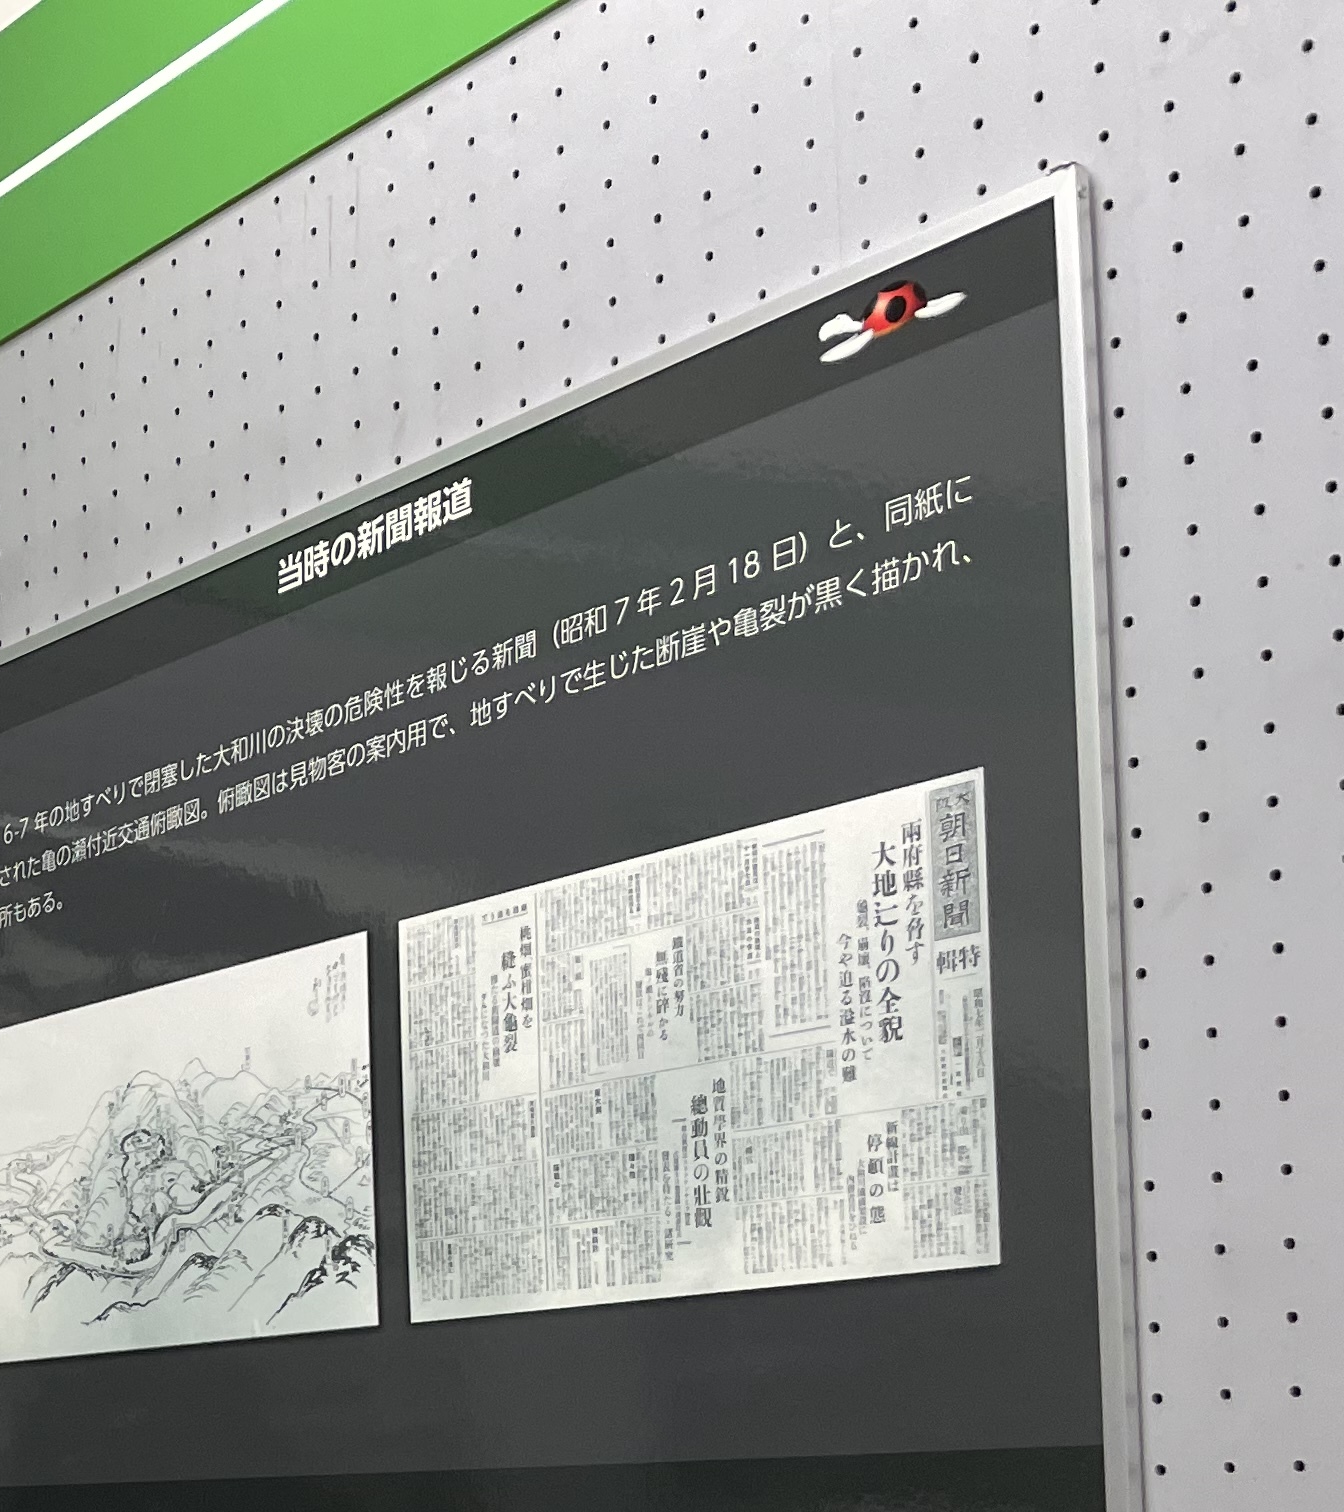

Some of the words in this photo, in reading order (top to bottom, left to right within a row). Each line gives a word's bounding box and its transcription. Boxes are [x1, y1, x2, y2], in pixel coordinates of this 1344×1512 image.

[277, 477, 472, 594] 当時の新聞報道
[938, 811, 971, 929] 朝日新聞
